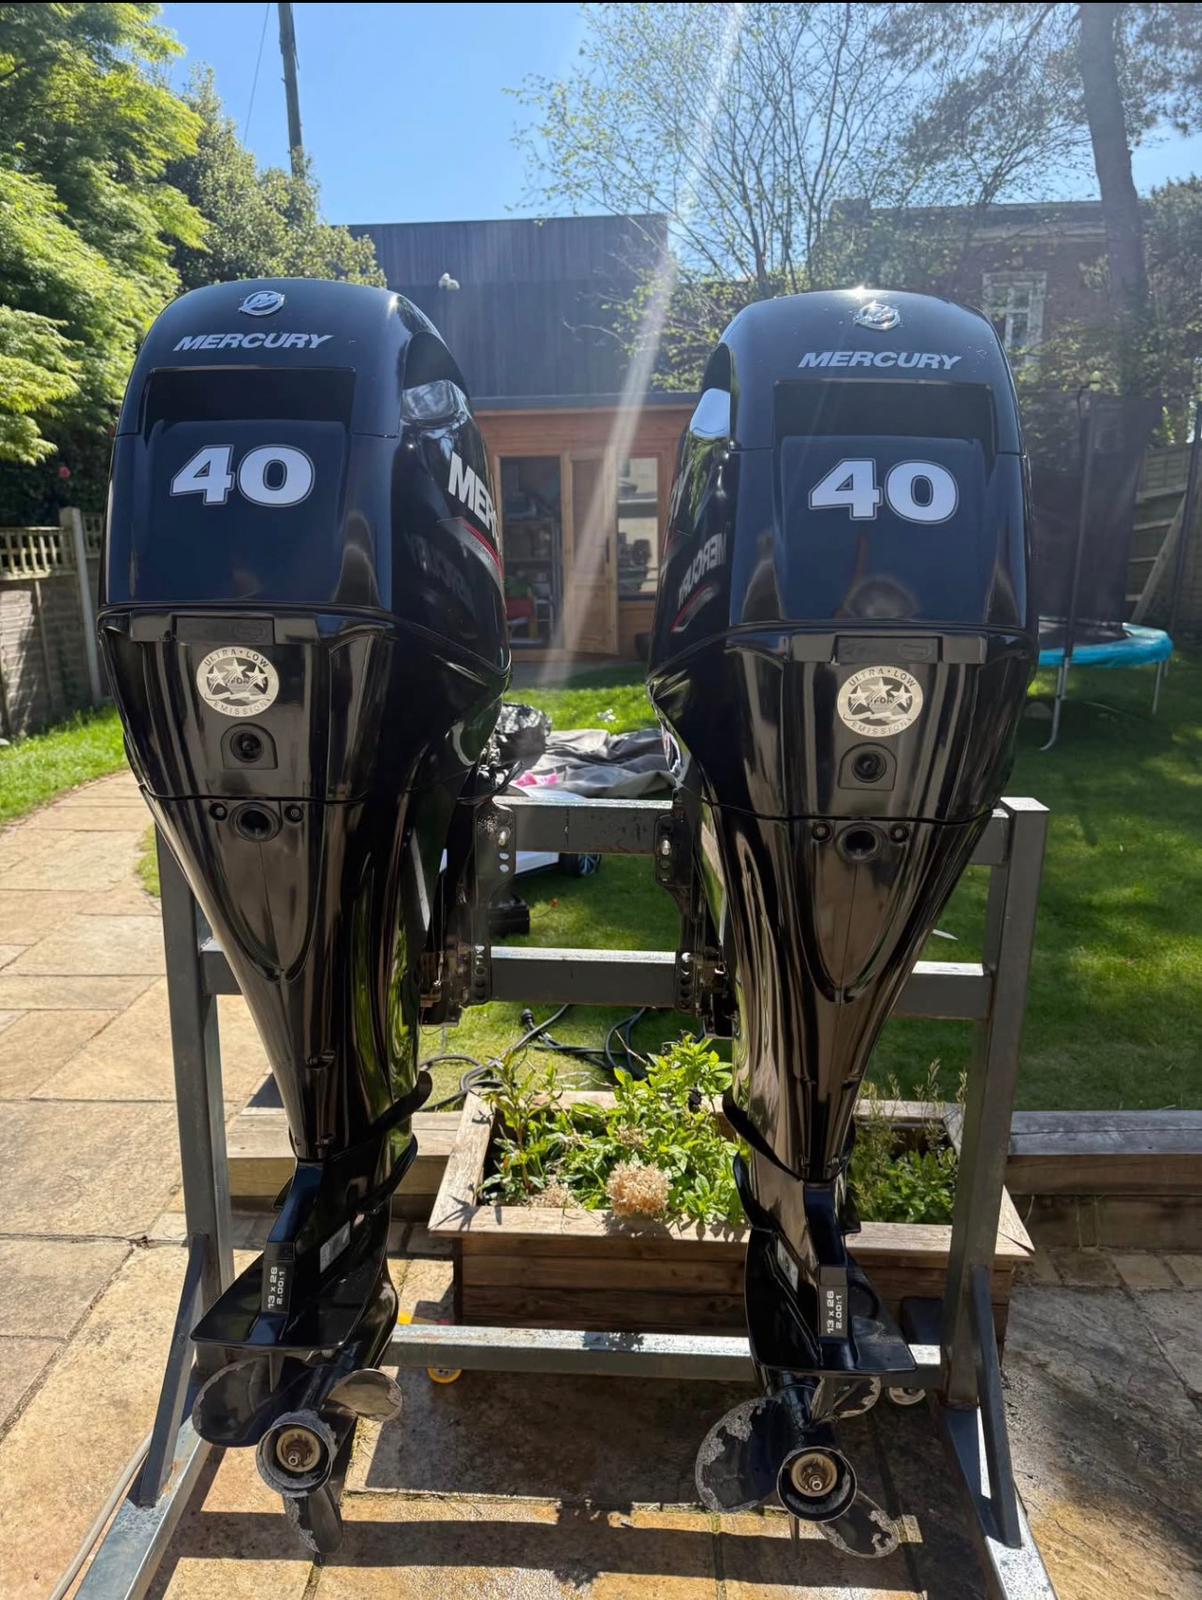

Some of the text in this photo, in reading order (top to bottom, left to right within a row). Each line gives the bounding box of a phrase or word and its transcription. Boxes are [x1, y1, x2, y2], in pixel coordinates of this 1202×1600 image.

[173, 333, 333, 351] MERCURY
[798, 351, 962, 369] MERCURY
[170, 444, 315, 507] 40
[808, 458, 959, 524] 40
[246, 651, 269, 667] LOW
[848, 668, 916, 687] ULTRA LOW
[270, 1266, 278, 1283] 26
[267, 1295, 275, 1309] 13
[826, 1290, 834, 1307] 26
[826, 1319, 834, 1333] 13
